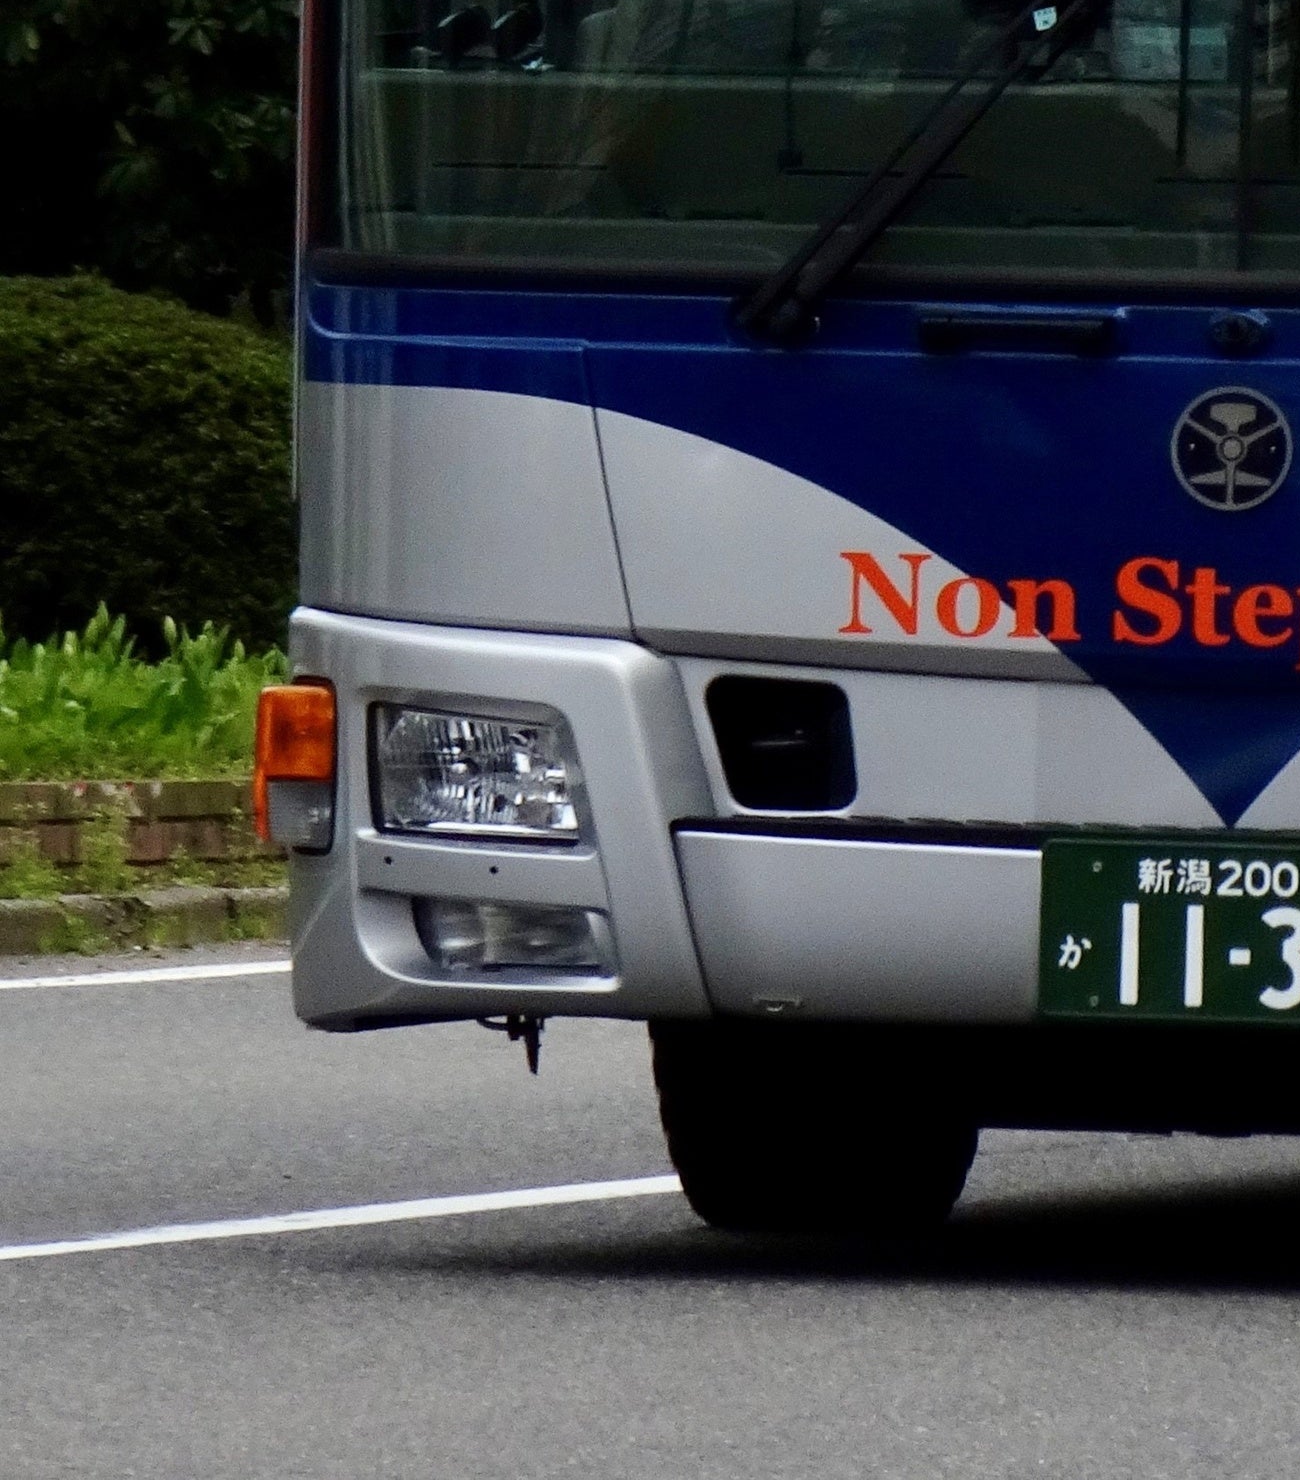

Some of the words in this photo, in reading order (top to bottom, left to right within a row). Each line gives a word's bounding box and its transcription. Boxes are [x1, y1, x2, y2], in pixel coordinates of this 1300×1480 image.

[838, 551, 1082, 640] Non
[1138, 858, 1300, 898] 新潟200
[1058, 934, 1093, 970] か
